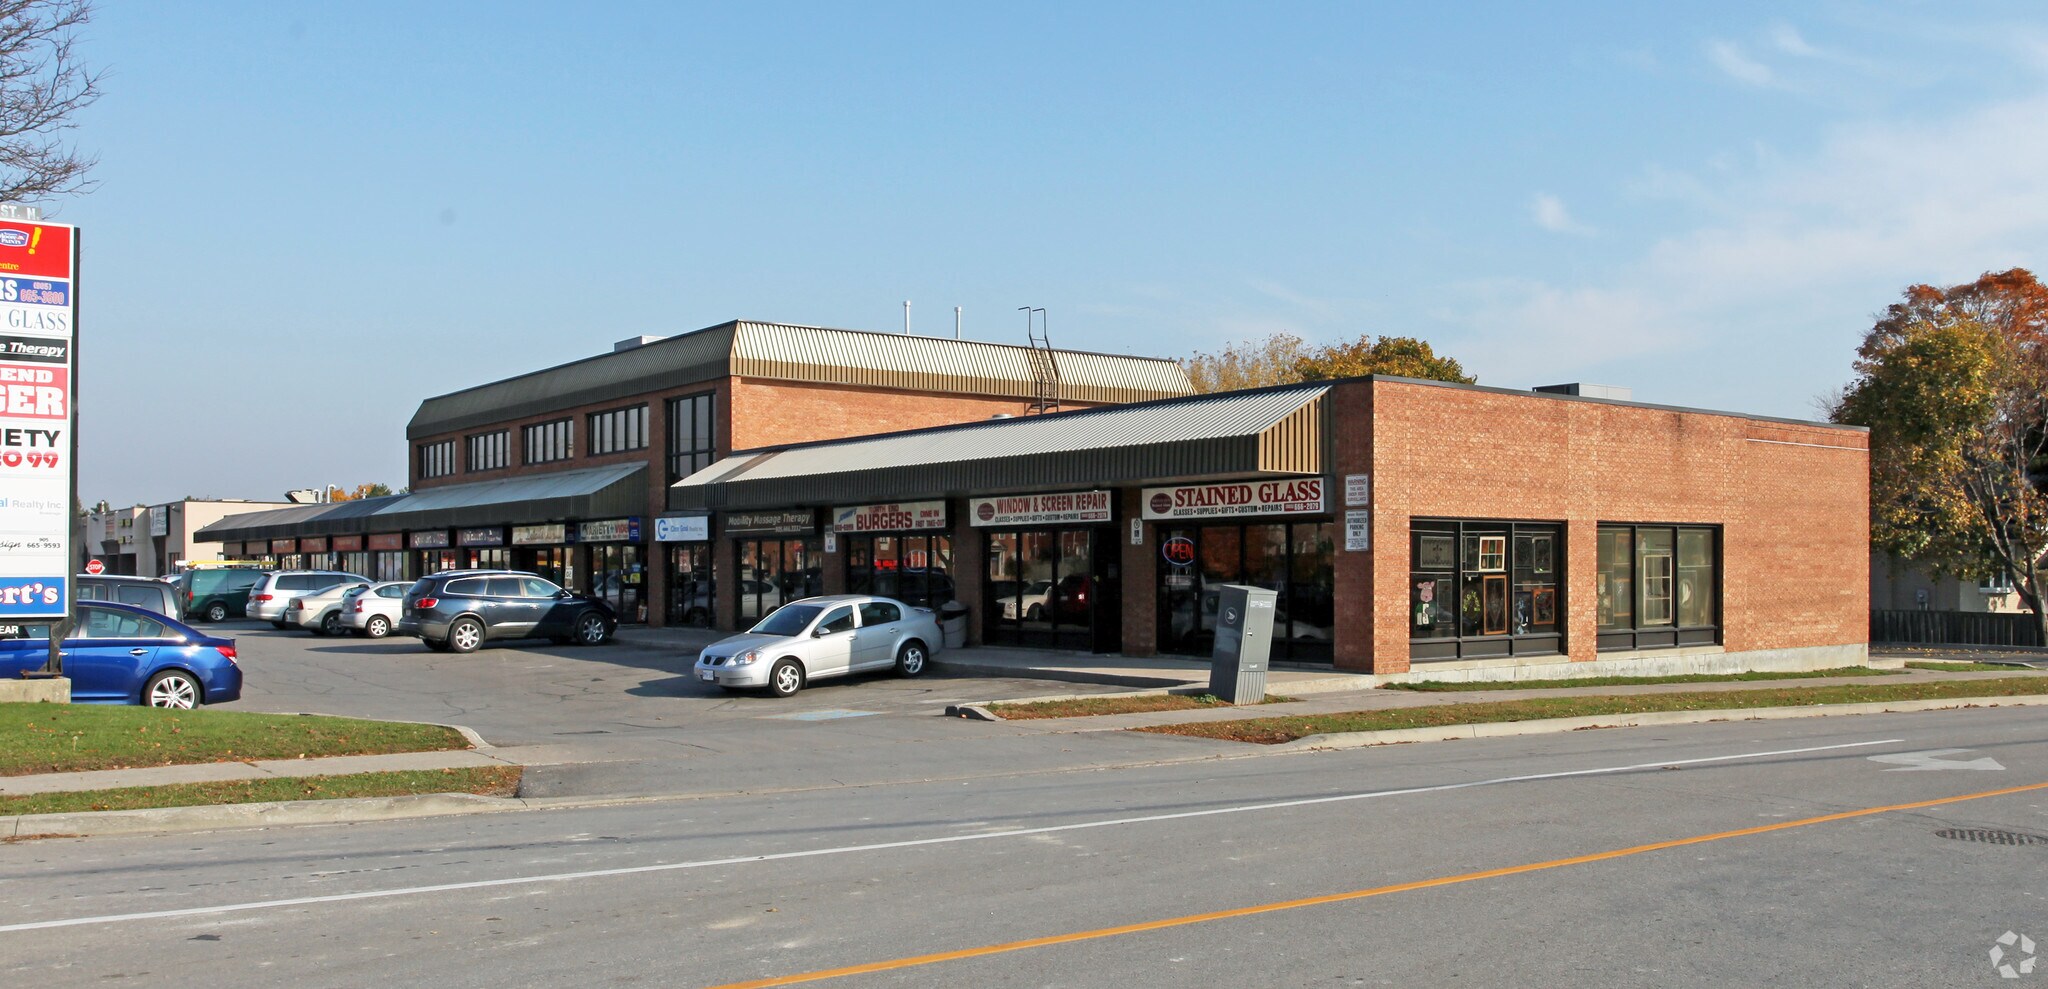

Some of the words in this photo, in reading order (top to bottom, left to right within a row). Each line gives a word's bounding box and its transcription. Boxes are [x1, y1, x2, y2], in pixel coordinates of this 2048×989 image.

[27, 207, 40, 220] N.
[9, 308, 67, 332] GLASS
[10, 342, 65, 358] Therapy
[0, 367, 54, 384] END
[27, 450, 59, 469] 99
[1174, 484, 1253, 508] STAINED
[1257, 479, 1321, 503] GLASS
[12, 499, 45, 510] Realty
[47, 500, 65, 509] Inc.
[996, 497, 1031, 514] WINDOW
[1033, 496, 1039, 513] &
[1041, 494, 1073, 512] SCREEN
[1075, 492, 1107, 510] REPAIR
[1196, 507, 1218, 515] SUPPLIES
[1221, 506, 1235, 515] GIFTS
[1237, 505, 1258, 514] CUSTOM
[1261, 503, 1283, 513] REPAIRS
[727, 515, 752, 527] Mobility
[753, 515, 781, 526] Massage
[782, 512, 811, 525] Therapy
[856, 511, 913, 530] BURGERS
[920, 510, 932, 518] DINE
[933, 509, 940, 517] IN
[1164, 543, 1194, 560] OPEN
[89, 563, 103, 571] STOP
